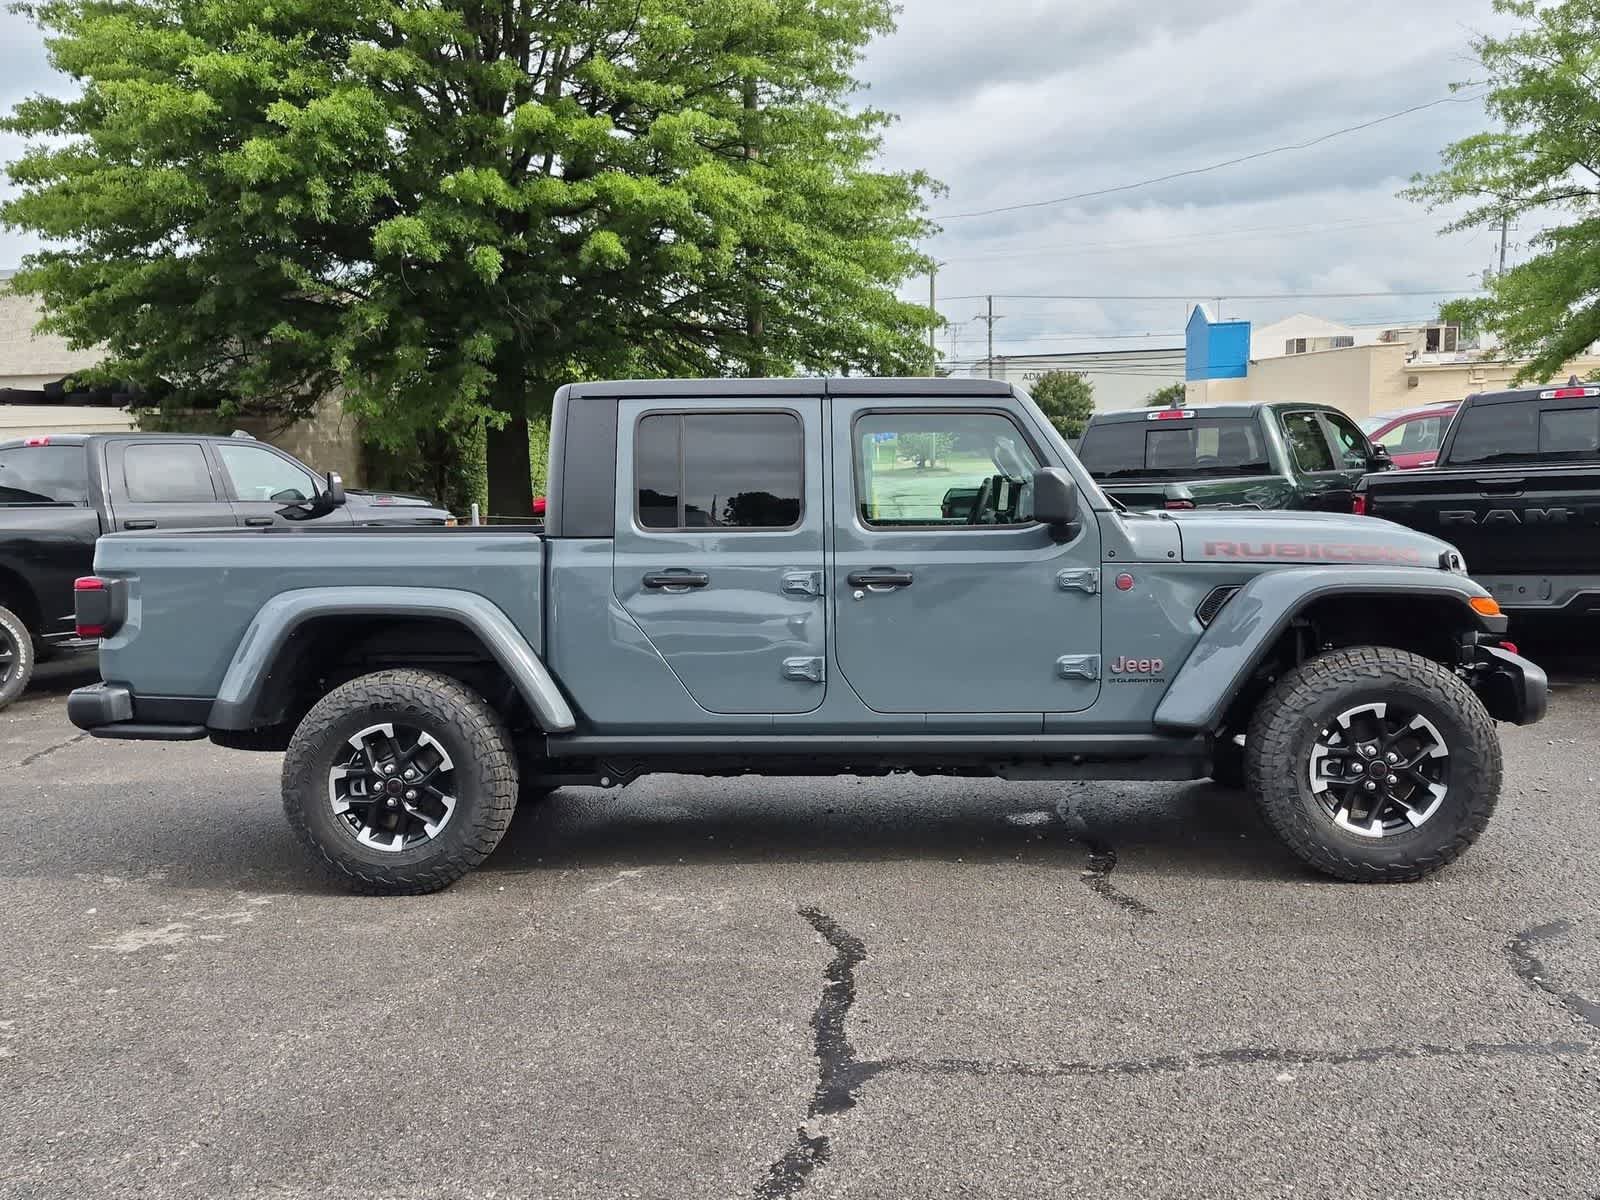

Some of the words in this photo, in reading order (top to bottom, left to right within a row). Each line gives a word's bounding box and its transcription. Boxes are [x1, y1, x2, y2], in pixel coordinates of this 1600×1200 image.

[1439, 507, 1575, 525] RAM
[1204, 541, 1420, 563] RUBICON
[1111, 655, 1164, 676] Jeep
